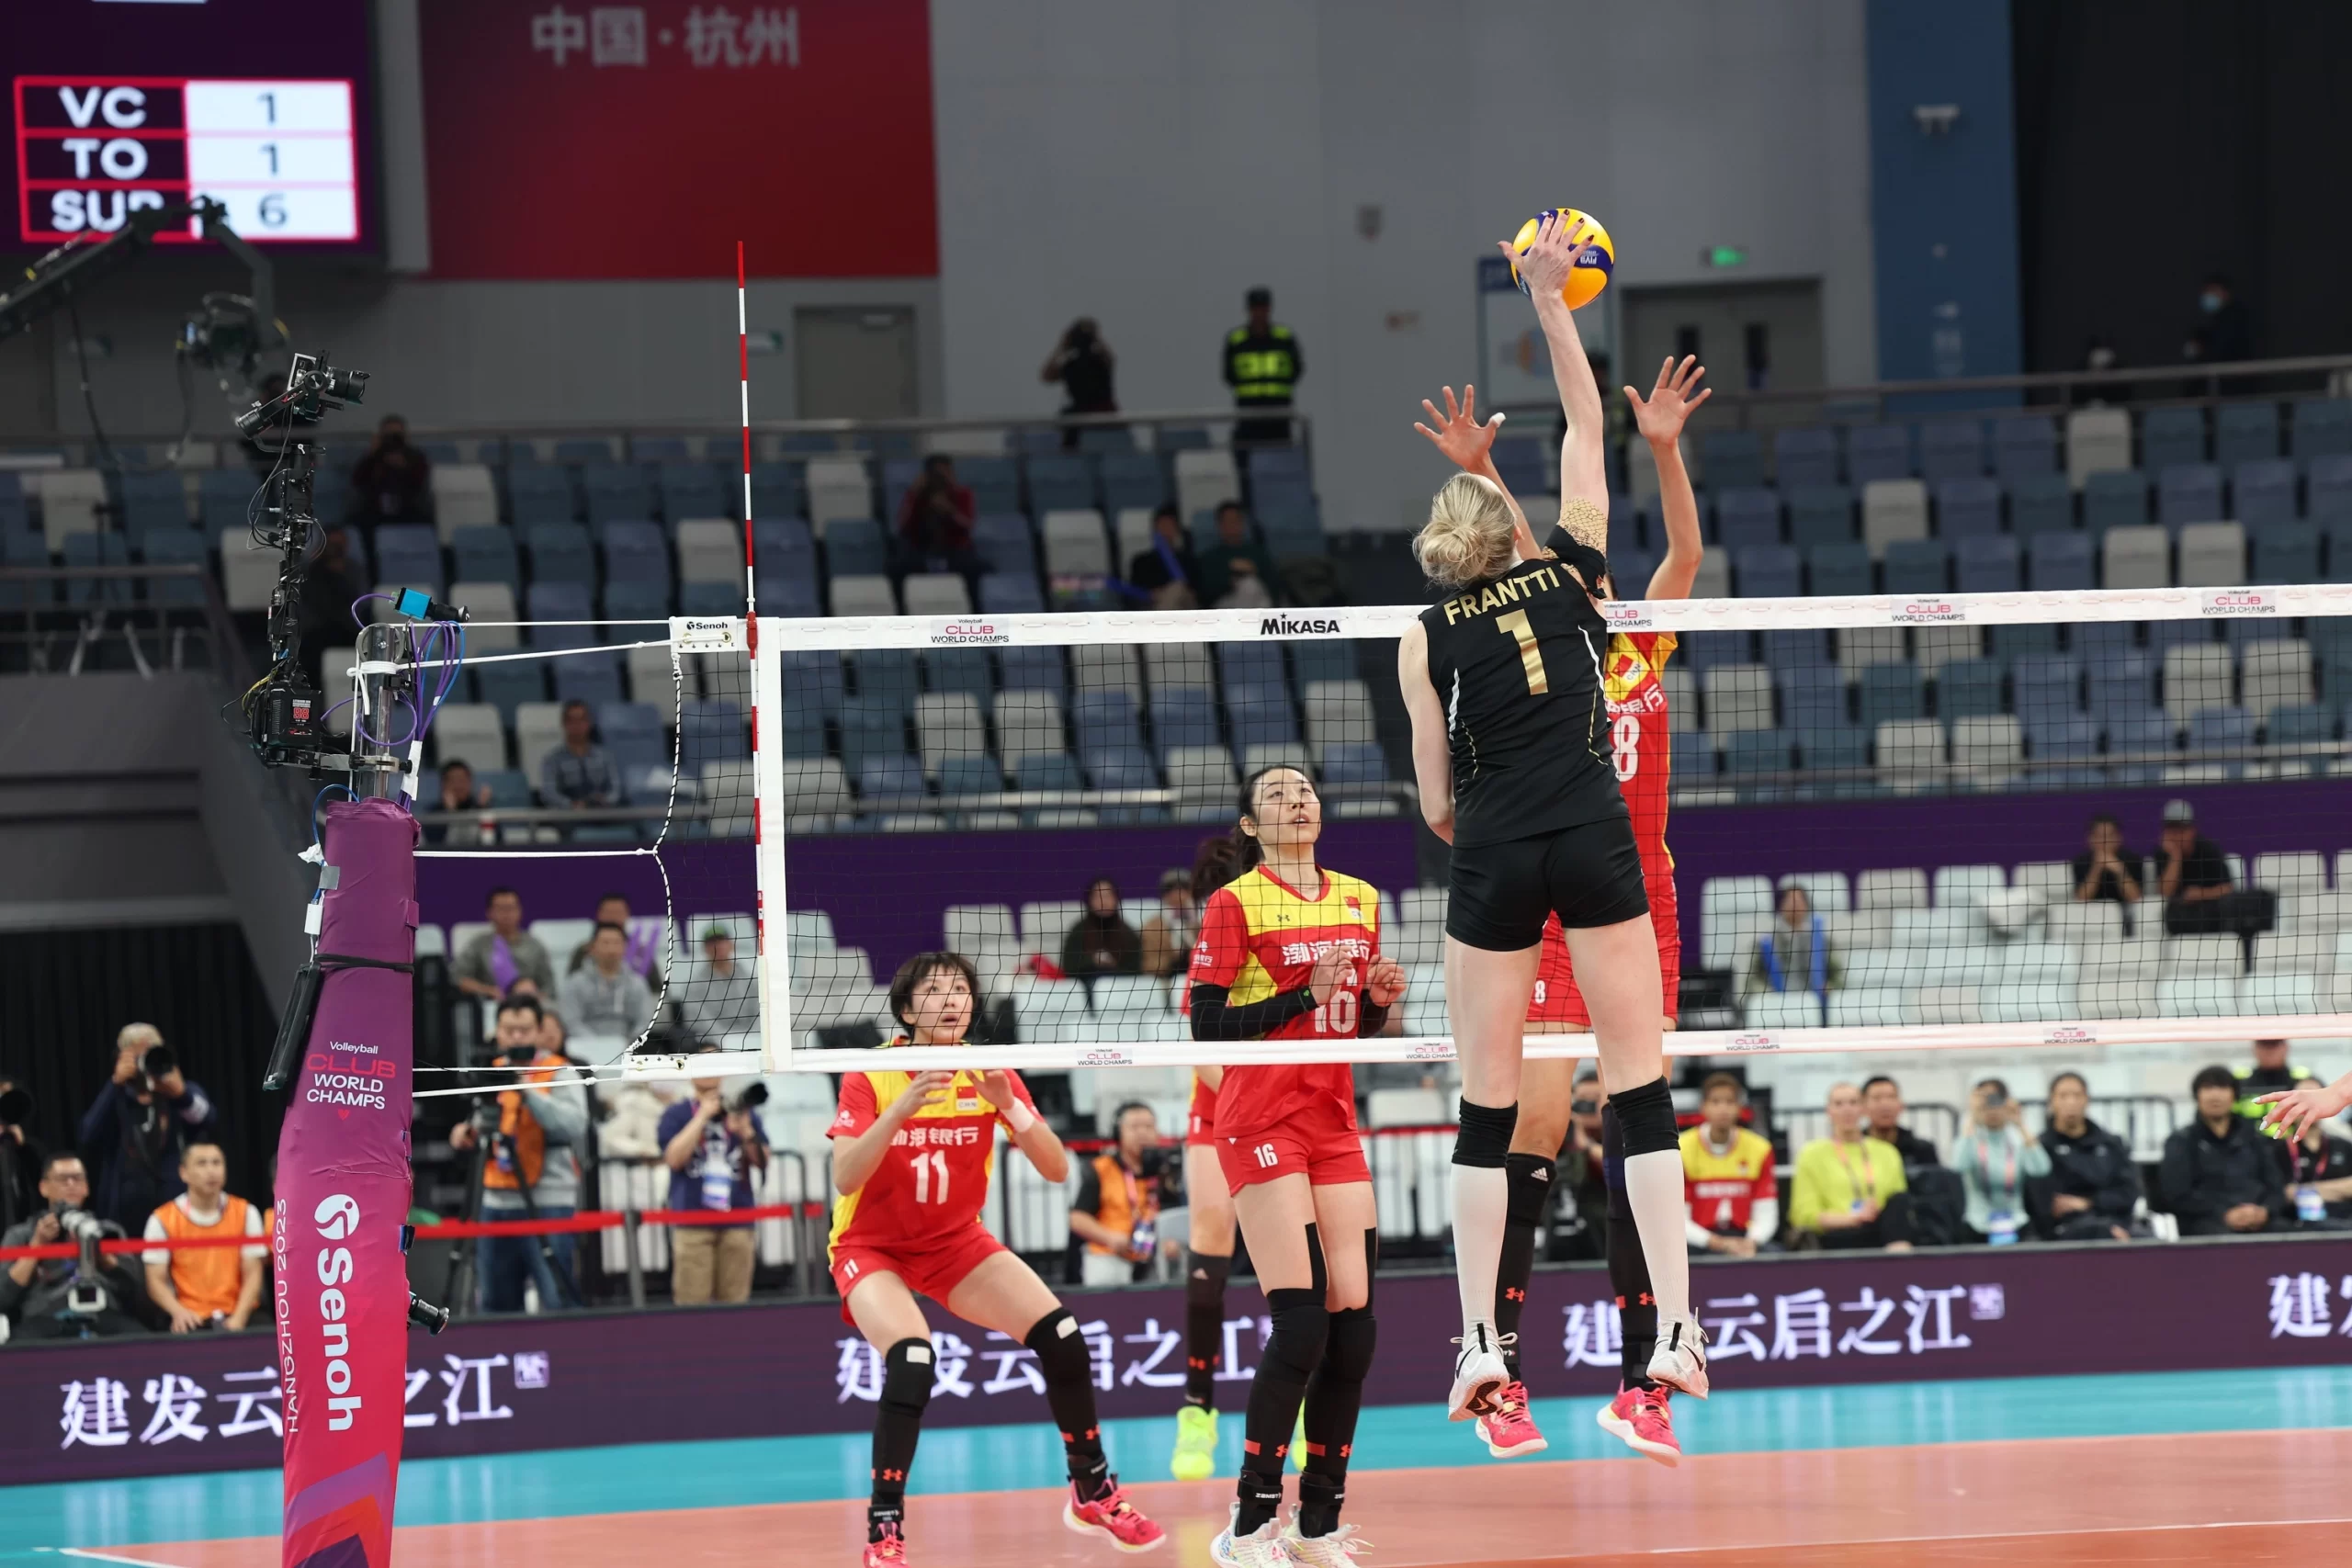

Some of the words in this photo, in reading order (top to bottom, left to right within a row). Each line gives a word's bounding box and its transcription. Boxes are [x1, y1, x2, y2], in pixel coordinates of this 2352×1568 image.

[532, 5, 800, 68] 中国·杭州
[58, 85, 147, 129] VC
[256, 93, 277, 124] 1
[62, 138, 148, 180] TO
[260, 144, 279, 175] 1
[258, 192, 288, 227] 6
[1443, 567, 1560, 626] FRANTTI
[1905, 604, 1951, 614] CLUB
[2215, 596, 2261, 605] CLUB
[695, 622, 729, 630] Senoh
[1606, 610, 1638, 619] LUB
[945, 626, 994, 635] CLUB
[1495, 608, 1548, 695] 1
[293, 707, 310, 719] 98
[1611, 715, 1640, 783] 8
[1535, 980, 1545, 1003] 8
[329, 1041, 379, 1055] Volleyball
[306, 1053, 397, 1079] CLUB
[314, 1073, 384, 1093] WORLD
[306, 1089, 386, 1111] CHAMPS
[1253, 1143, 1279, 1168] 16
[910, 1149, 950, 1205] 11
[276, 1198, 288, 1271] 2023
[843, 1258, 860, 1280] 11
[2266, 1271, 2352, 1339] 建
[317, 1247, 362, 1431] Senoh
[1562, 1284, 1973, 1370] 建云启之江
[277, 1280, 299, 1433] HANGZHOU
